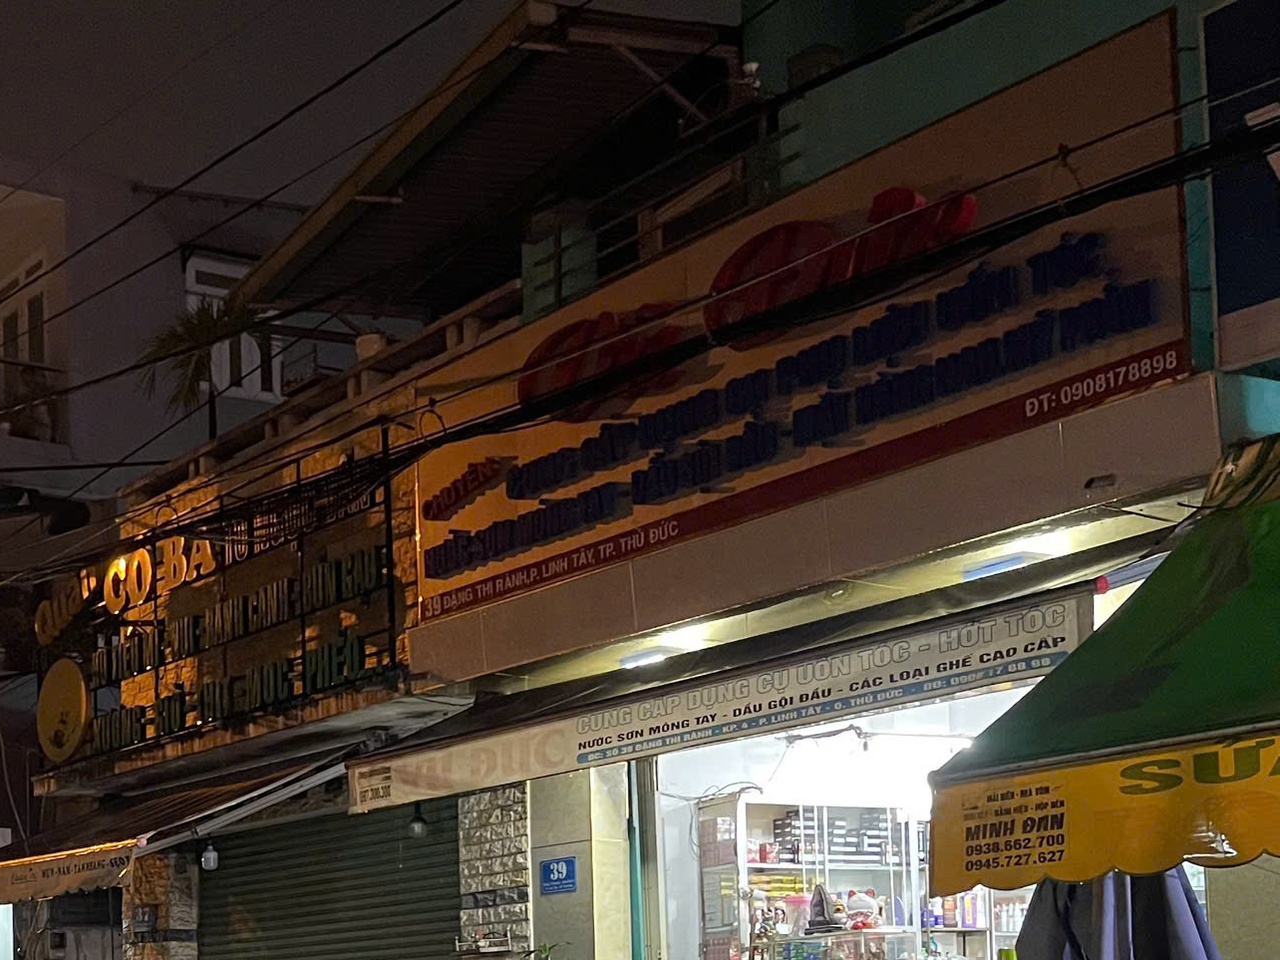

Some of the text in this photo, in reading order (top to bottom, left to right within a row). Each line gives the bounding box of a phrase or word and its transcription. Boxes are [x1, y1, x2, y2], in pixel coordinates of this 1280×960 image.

[1025, 350, 1177, 417] ĐT: 0908178898
[156, 535, 217, 598] BA
[423, 597, 442, 618] 39
[542, 558, 569, 578] LINH
[649, 519, 680, 544] ĐỨC
[577, 705, 634, 735] CUNG
[687, 678, 751, 711] DỤNG
[756, 668, 790, 695] CỤ
[616, 728, 645, 744] SƠN
[694, 712, 719, 726] TAY
[848, 676, 883, 692] CÁC
[889, 664, 930, 684] LOẠI
[936, 652, 974, 675] GHẾ
[978, 645, 1018, 664] CAO
[771, 711, 797, 724] LINH
[964, 833, 1065, 857] 0938.662.700
[965, 818, 1016, 842] MINH
[550, 861, 567, 881] 39
[964, 849, 1065, 872] 0945.727.627
